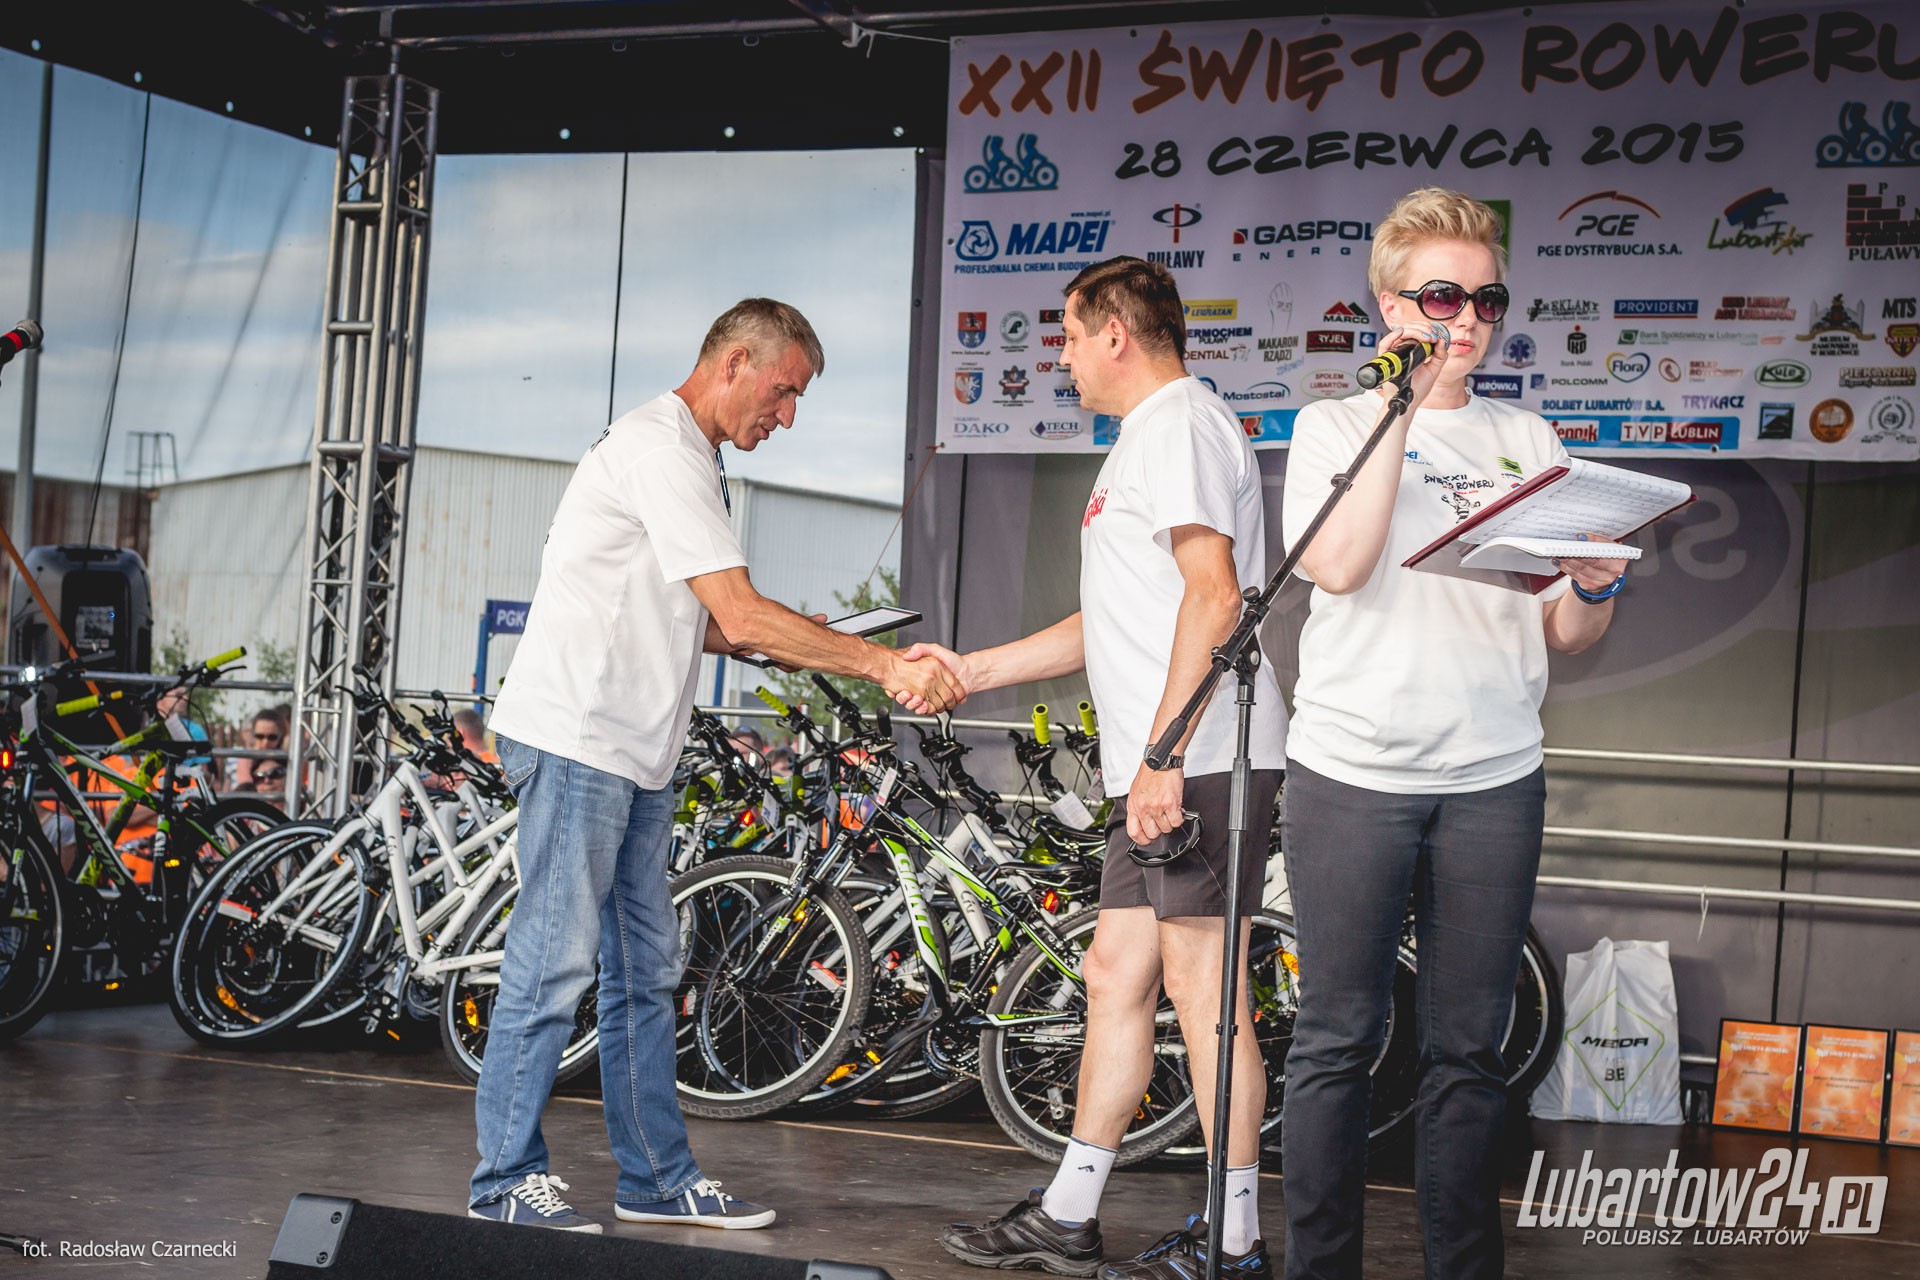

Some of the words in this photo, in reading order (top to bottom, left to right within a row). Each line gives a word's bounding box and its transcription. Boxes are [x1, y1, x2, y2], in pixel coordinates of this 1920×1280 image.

[958, 48, 1102, 118] XXII
[1131, 27, 1485, 115] ŚWIĘTO
[1521, 5, 1920, 94] ROWERU
[1114, 140, 1182, 180] 28
[1207, 124, 1552, 176] CZERWCA
[1581, 120, 1745, 165] 2015
[1575, 214, 1640, 237] PGE
[1005, 220, 1110, 256] MAPEI
[1254, 220, 1375, 245] GASPOL
[1537, 245, 1562, 257] PGE
[1564, 243, 1655, 257] DYSTRYBUCJA
[1658, 243, 1683, 256] S.A.
[954, 263, 1022, 274] PROFESJONALNA
[1024, 262, 1056, 272] CHEMIA
[1618, 301, 1694, 313] PROVIDENT
[1882, 297, 1917, 319] MTS
[1323, 314, 1370, 325] MARCO
[1186, 327, 1253, 338] ERMOCHEM
[1258, 335, 1299, 350] MAKARON
[1036, 362, 1054, 373] OSP
[1612, 360, 1644, 373] Flora
[1840, 366, 1917, 378] PIEKARNIA
[1476, 380, 1519, 392] MRÓWKA
[1551, 378, 1609, 386] POLCOMM
[1223, 388, 1286, 401] Mostostal
[1541, 400, 1583, 410] SOLBET
[1585, 397, 1643, 411] LUBARTÓW
[1645, 400, 1665, 411] S.A.
[1681, 395, 1745, 410] TRYKACZ
[954, 422, 1010, 434] DAKO
[1045, 422, 1079, 431] TECH
[1623, 425, 1665, 439] TVP
[1669, 424, 1721, 439] LUBLIN
[1456, 479, 1495, 491] ROWERU
[496, 608, 527, 628] PGK
